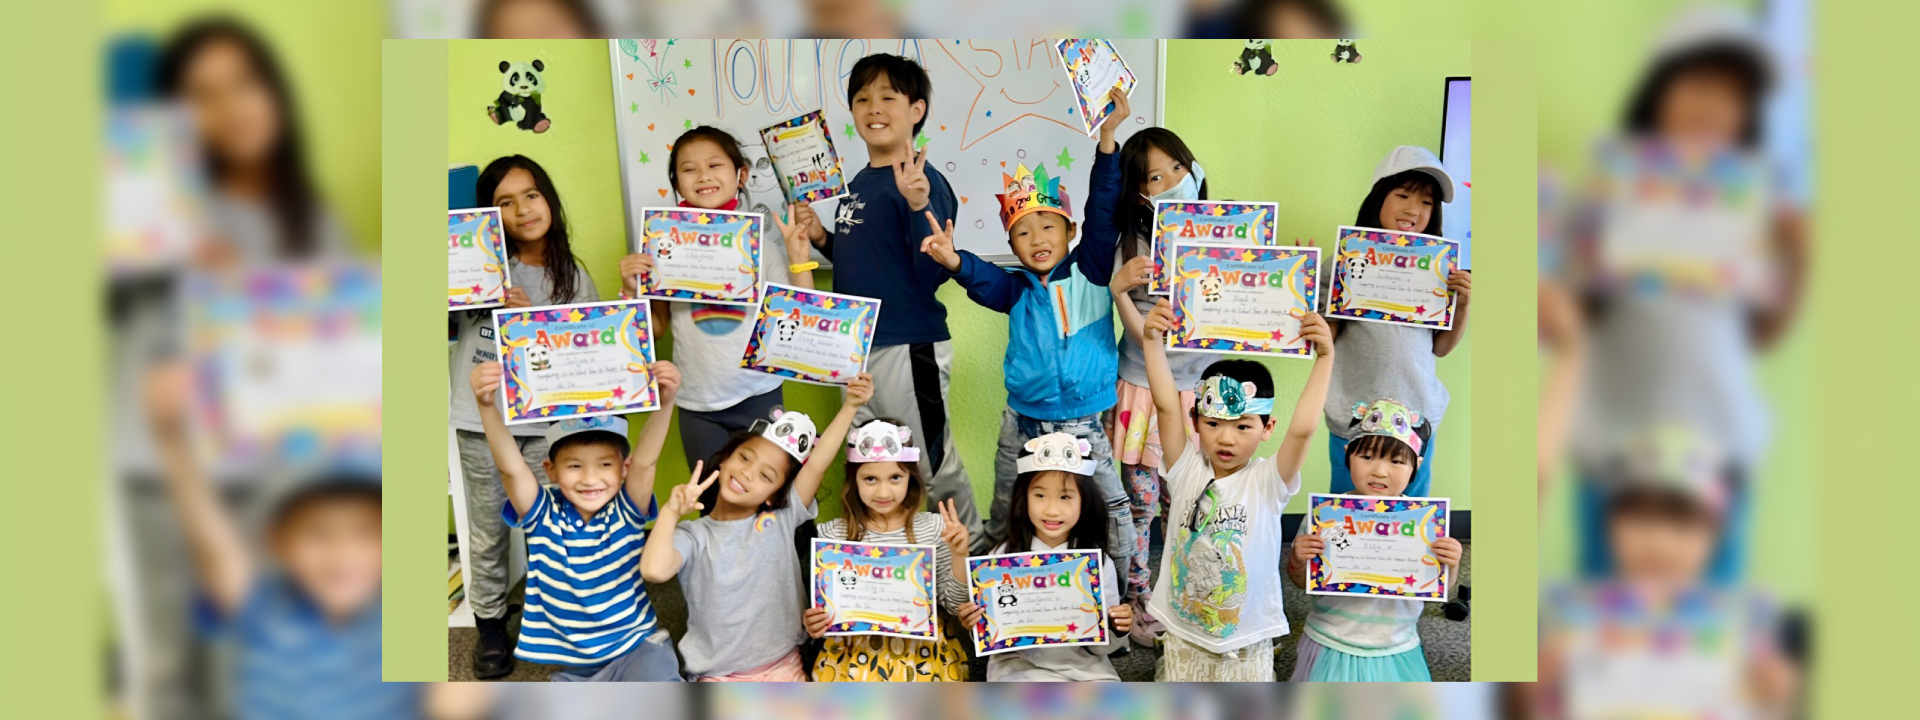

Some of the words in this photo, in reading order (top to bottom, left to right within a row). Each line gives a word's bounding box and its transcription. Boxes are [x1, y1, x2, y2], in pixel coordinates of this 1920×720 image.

[1016, 195, 1031, 209] 2nd
[670, 226, 733, 247] Award
[1180, 219, 1248, 239] Award
[1365, 247, 1432, 270] Award
[1206, 265, 1284, 288] Award
[788, 307, 852, 335] Award
[536, 325, 617, 351] Award
[1343, 516, 1415, 537] Award
[843, 559, 906, 580] Award
[1001, 570, 1071, 588] Award
